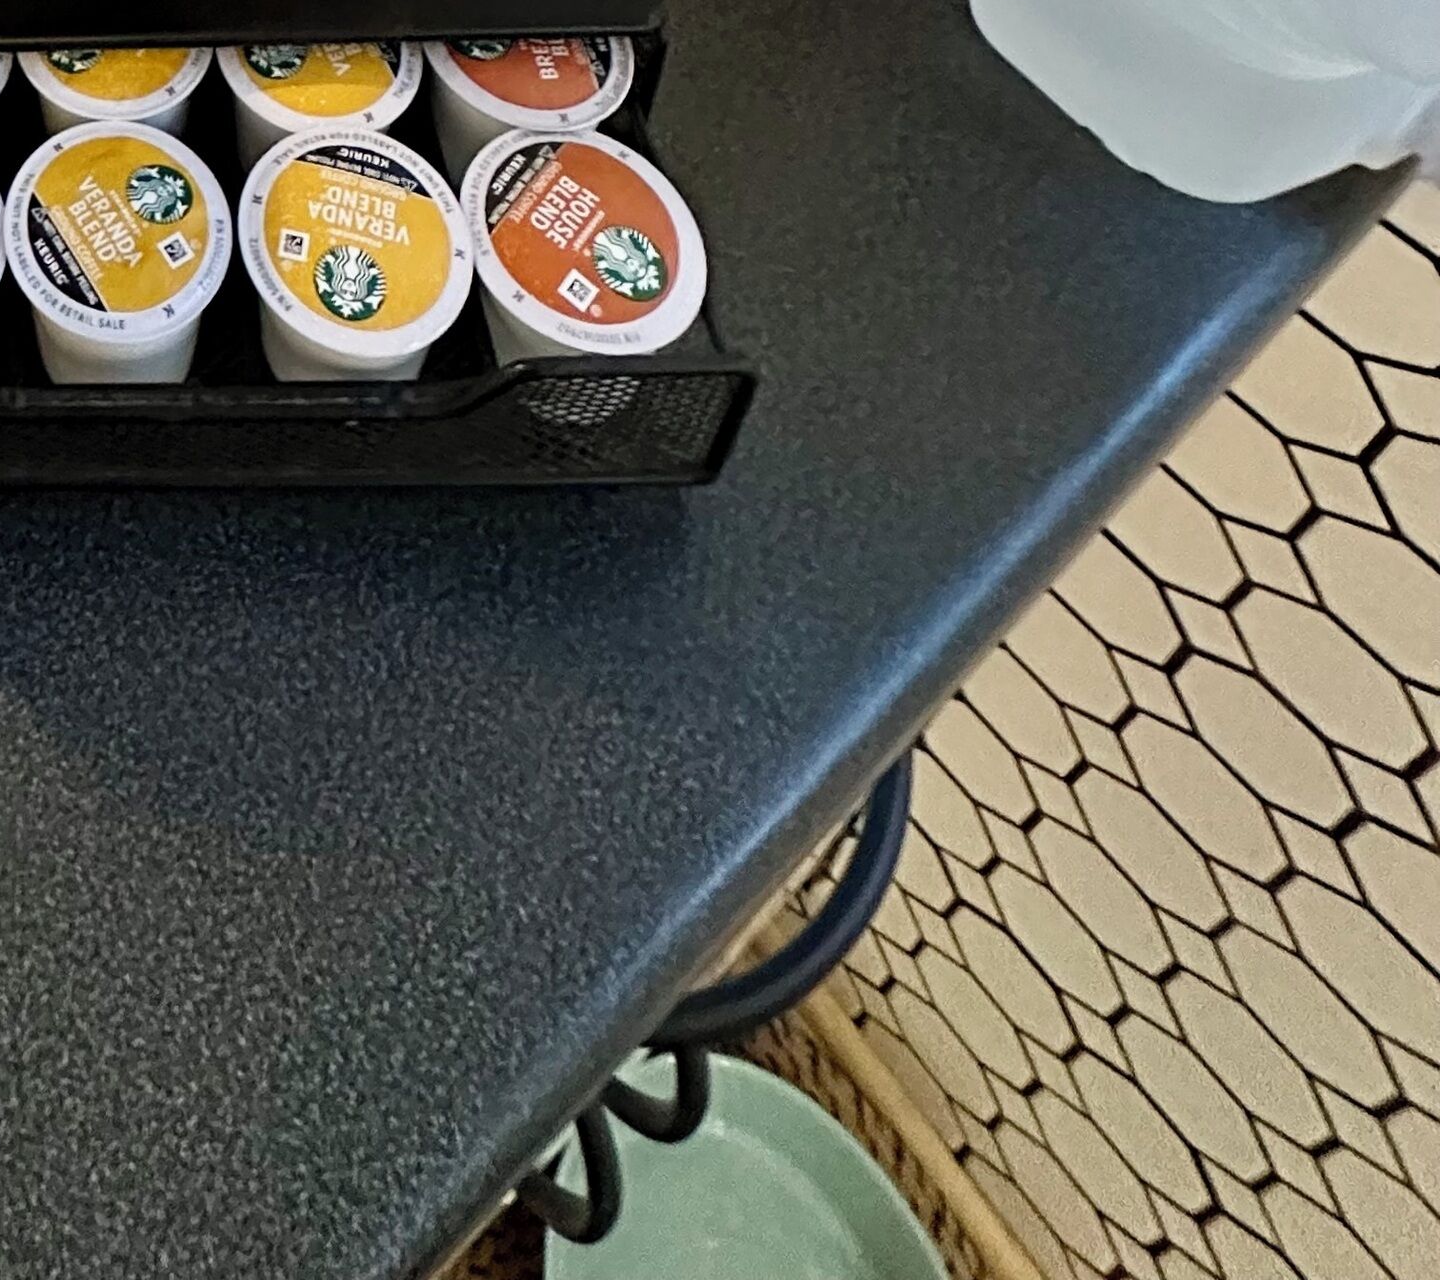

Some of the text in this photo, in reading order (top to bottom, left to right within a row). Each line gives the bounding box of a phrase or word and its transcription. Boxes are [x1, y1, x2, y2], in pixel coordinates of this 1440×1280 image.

[339, 148, 389, 168] KEURIG
[492, 154, 526, 193] KEURIG
[79, 176, 142, 267] VERANDA
[308, 200, 409, 245] VERANDA
[327, 186, 395, 219] BLEND
[530, 176, 580, 230] BLEND
[545, 188, 600, 249] HOUSE
[12, 222, 21, 241] NOT
[68, 200, 116, 261] BLEND
[13, 245, 41, 290] LABELED
[34, 238, 67, 284] KEURIG
[40, 289, 58, 308] FOR
[59, 304, 93, 326] RETAIL
[99, 318, 124, 330] SALE
